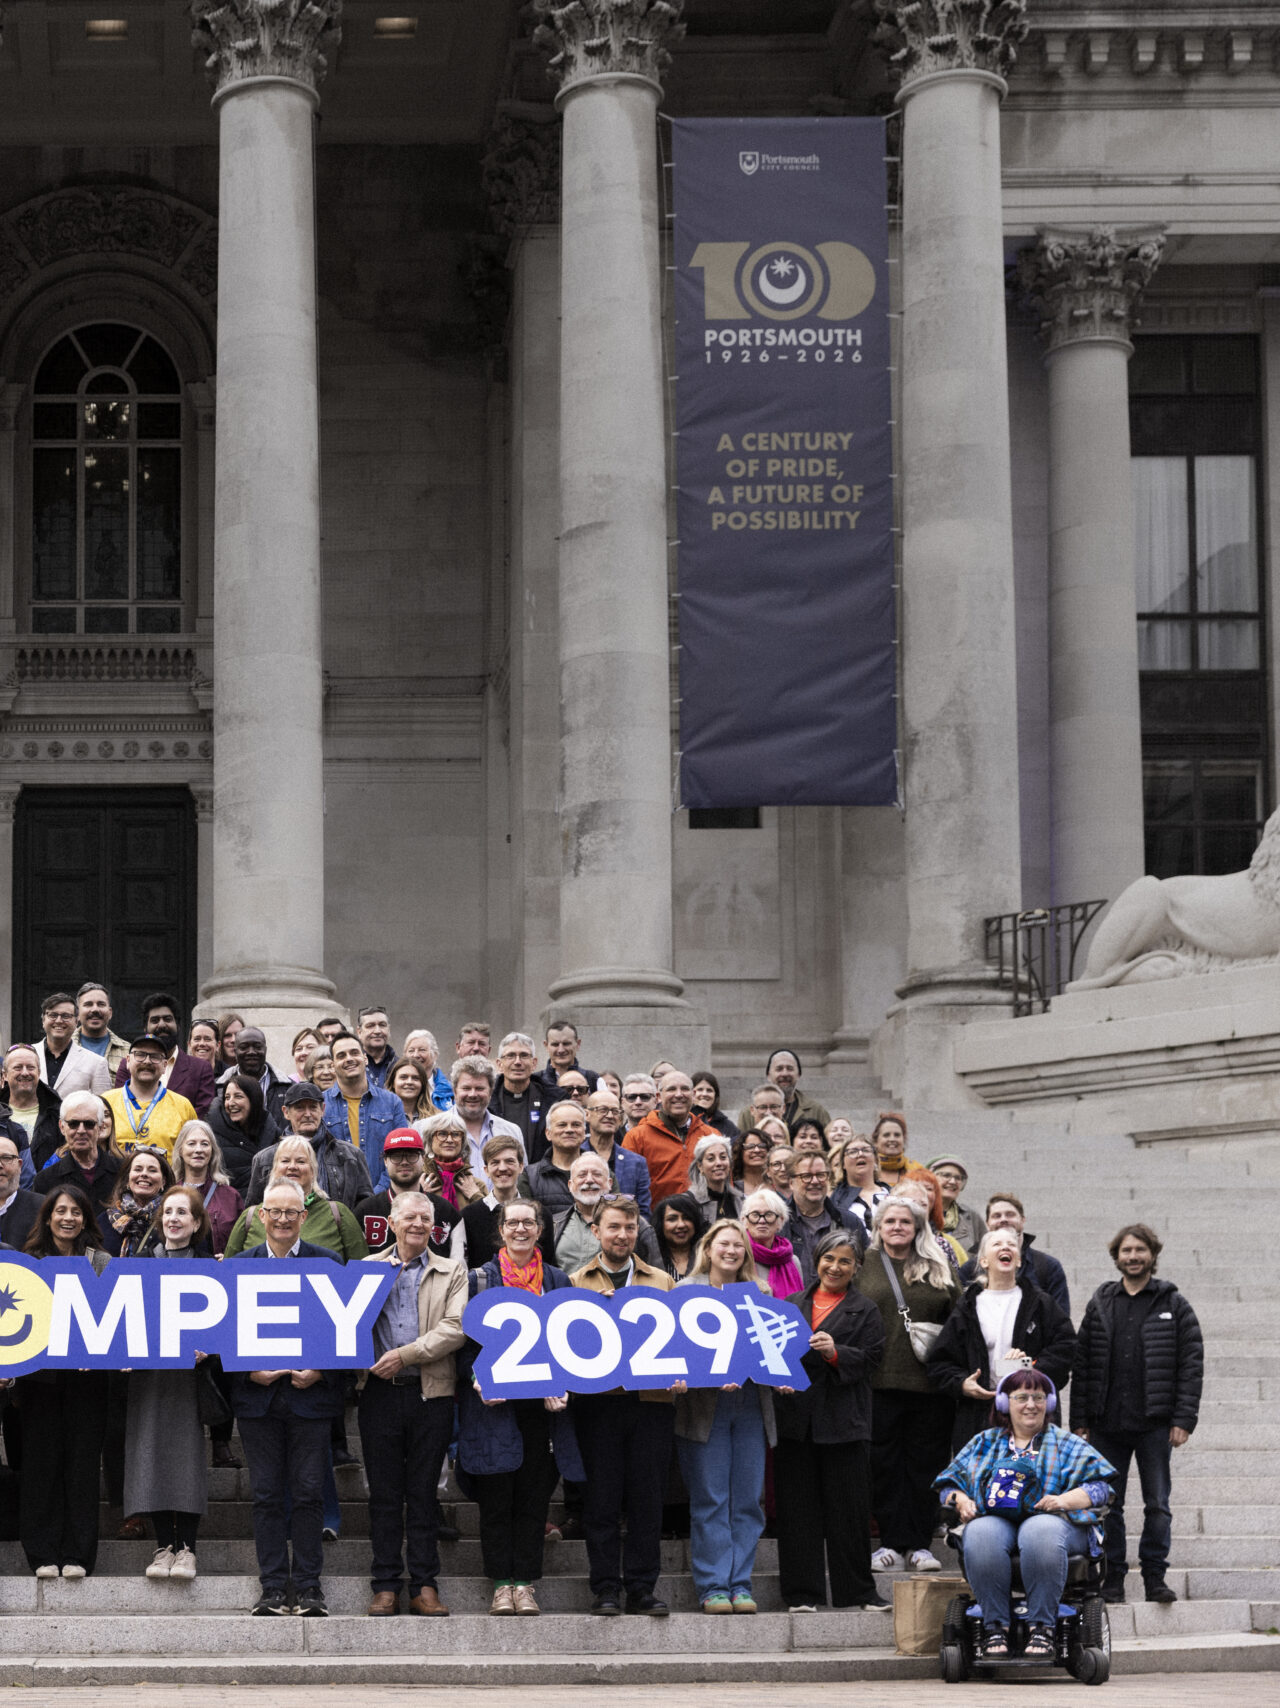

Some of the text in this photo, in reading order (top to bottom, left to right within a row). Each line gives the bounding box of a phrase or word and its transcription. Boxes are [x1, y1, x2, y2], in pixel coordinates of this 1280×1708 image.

[761, 153, 820, 164] Portsmouth
[689, 241, 876, 320] 100
[705, 328, 862, 347] PORTSMOUTH
[717, 432, 853, 451] A CENTURY
[726, 458, 844, 480] OF PRIDE,
[707, 485, 864, 504] A FUTURE OF
[712, 510, 860, 530] POSSIBILITY
[364, 1215, 388, 1247] B
[482, 1297, 739, 1384] 2029
